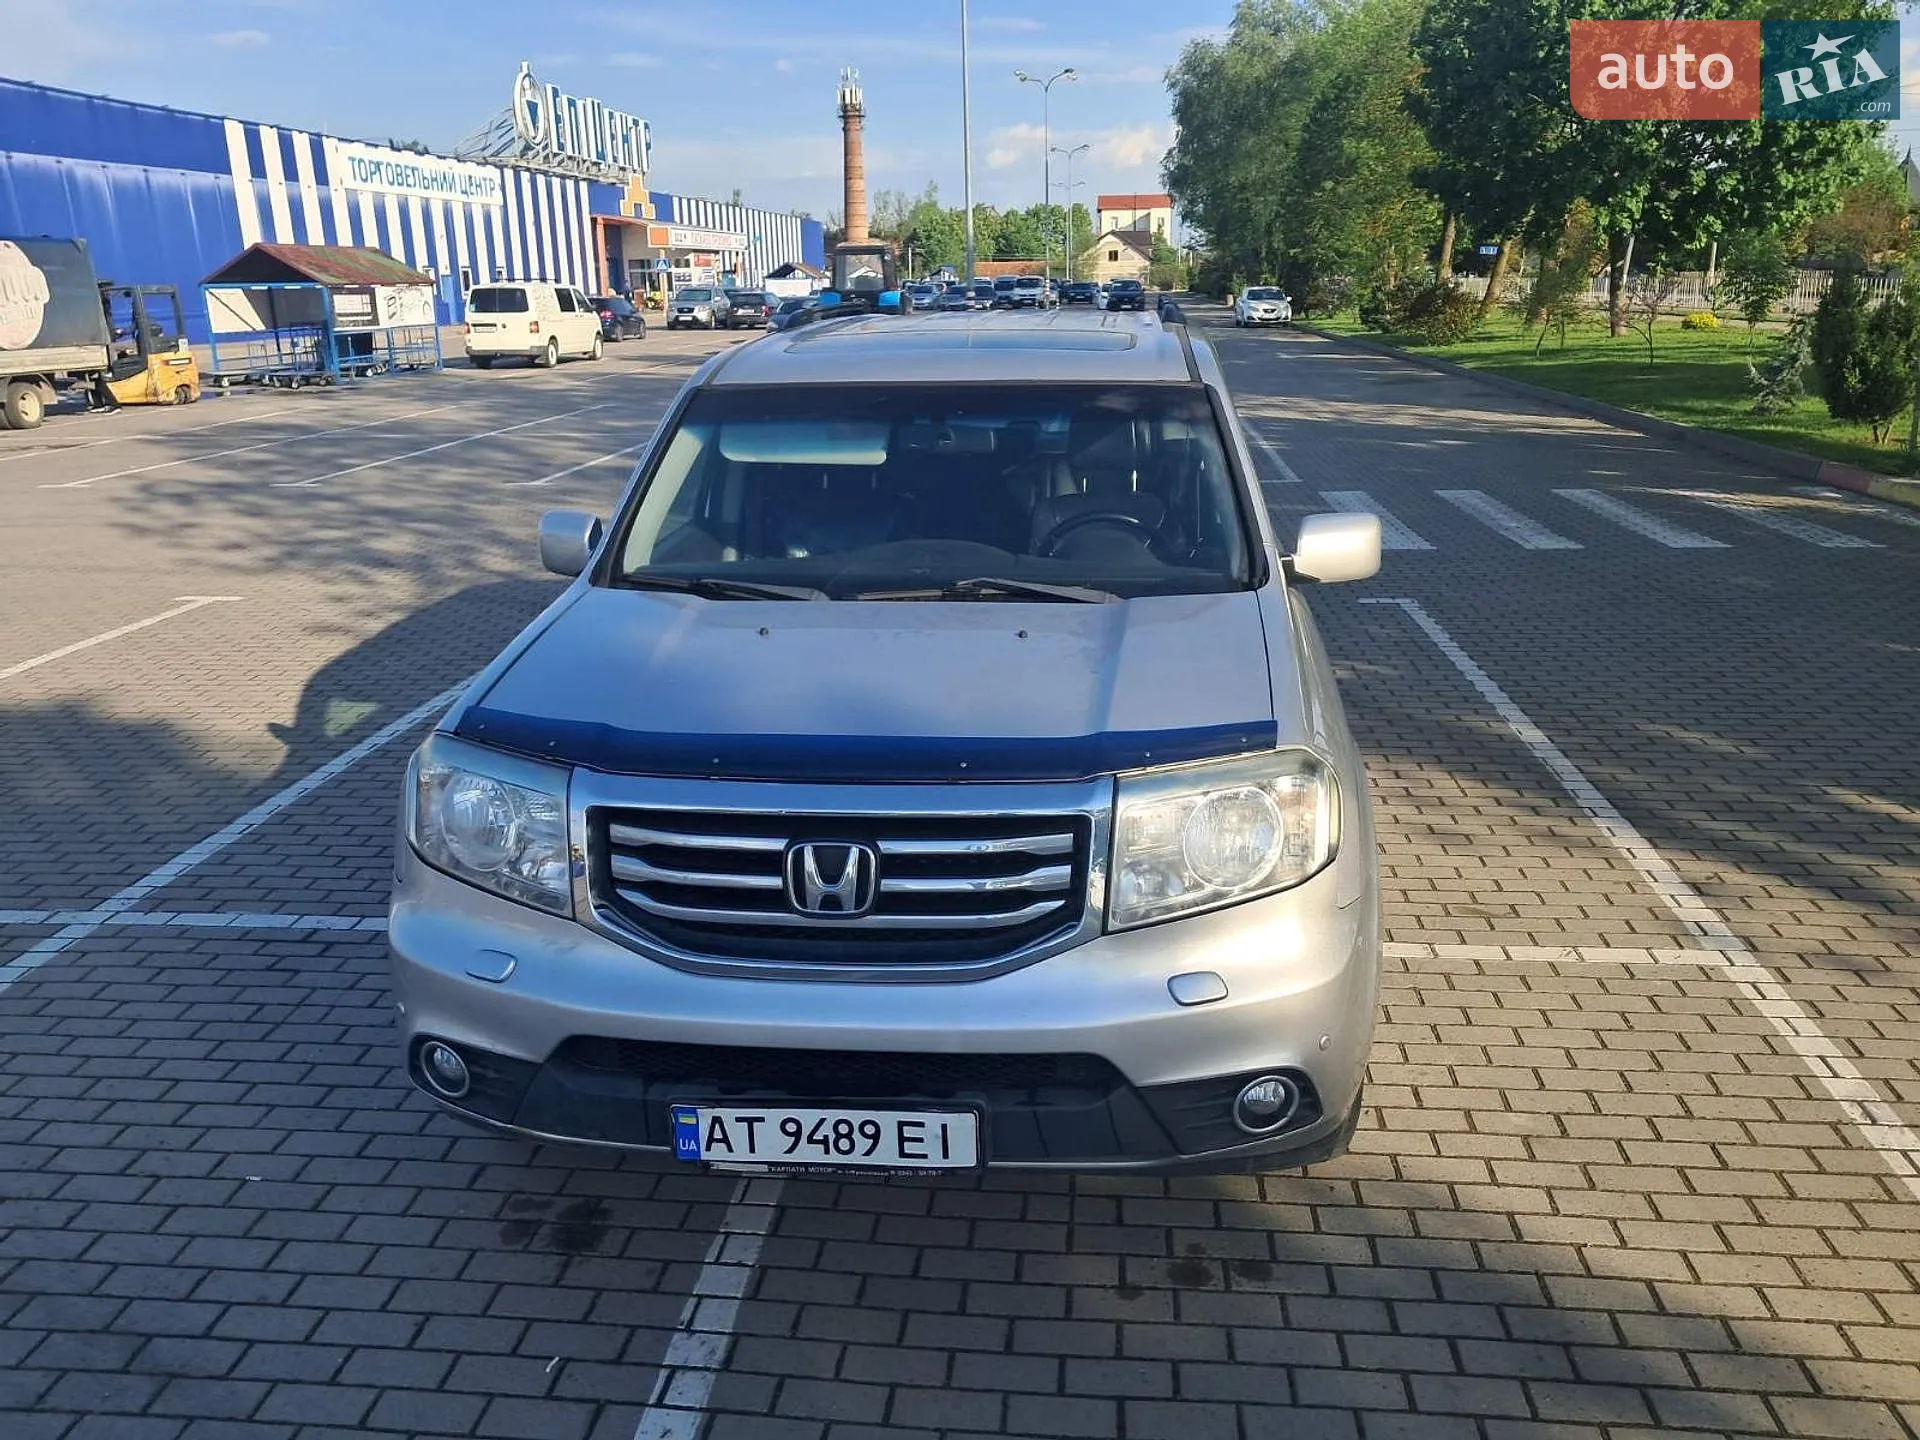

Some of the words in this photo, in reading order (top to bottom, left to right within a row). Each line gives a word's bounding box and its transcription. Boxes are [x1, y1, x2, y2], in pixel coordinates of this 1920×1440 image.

[545, 82, 653, 175] ЕПІЦЕНТР
[347, 155, 458, 195] ТОРГОВЕЛЬНИЙ
[457, 172, 497, 199] ЦЕНТР
[678, 1137, 698, 1152] UA
[704, 1115, 766, 1155] AT
[778, 1116, 881, 1157] 9489
[896, 1119, 950, 1160] EI
